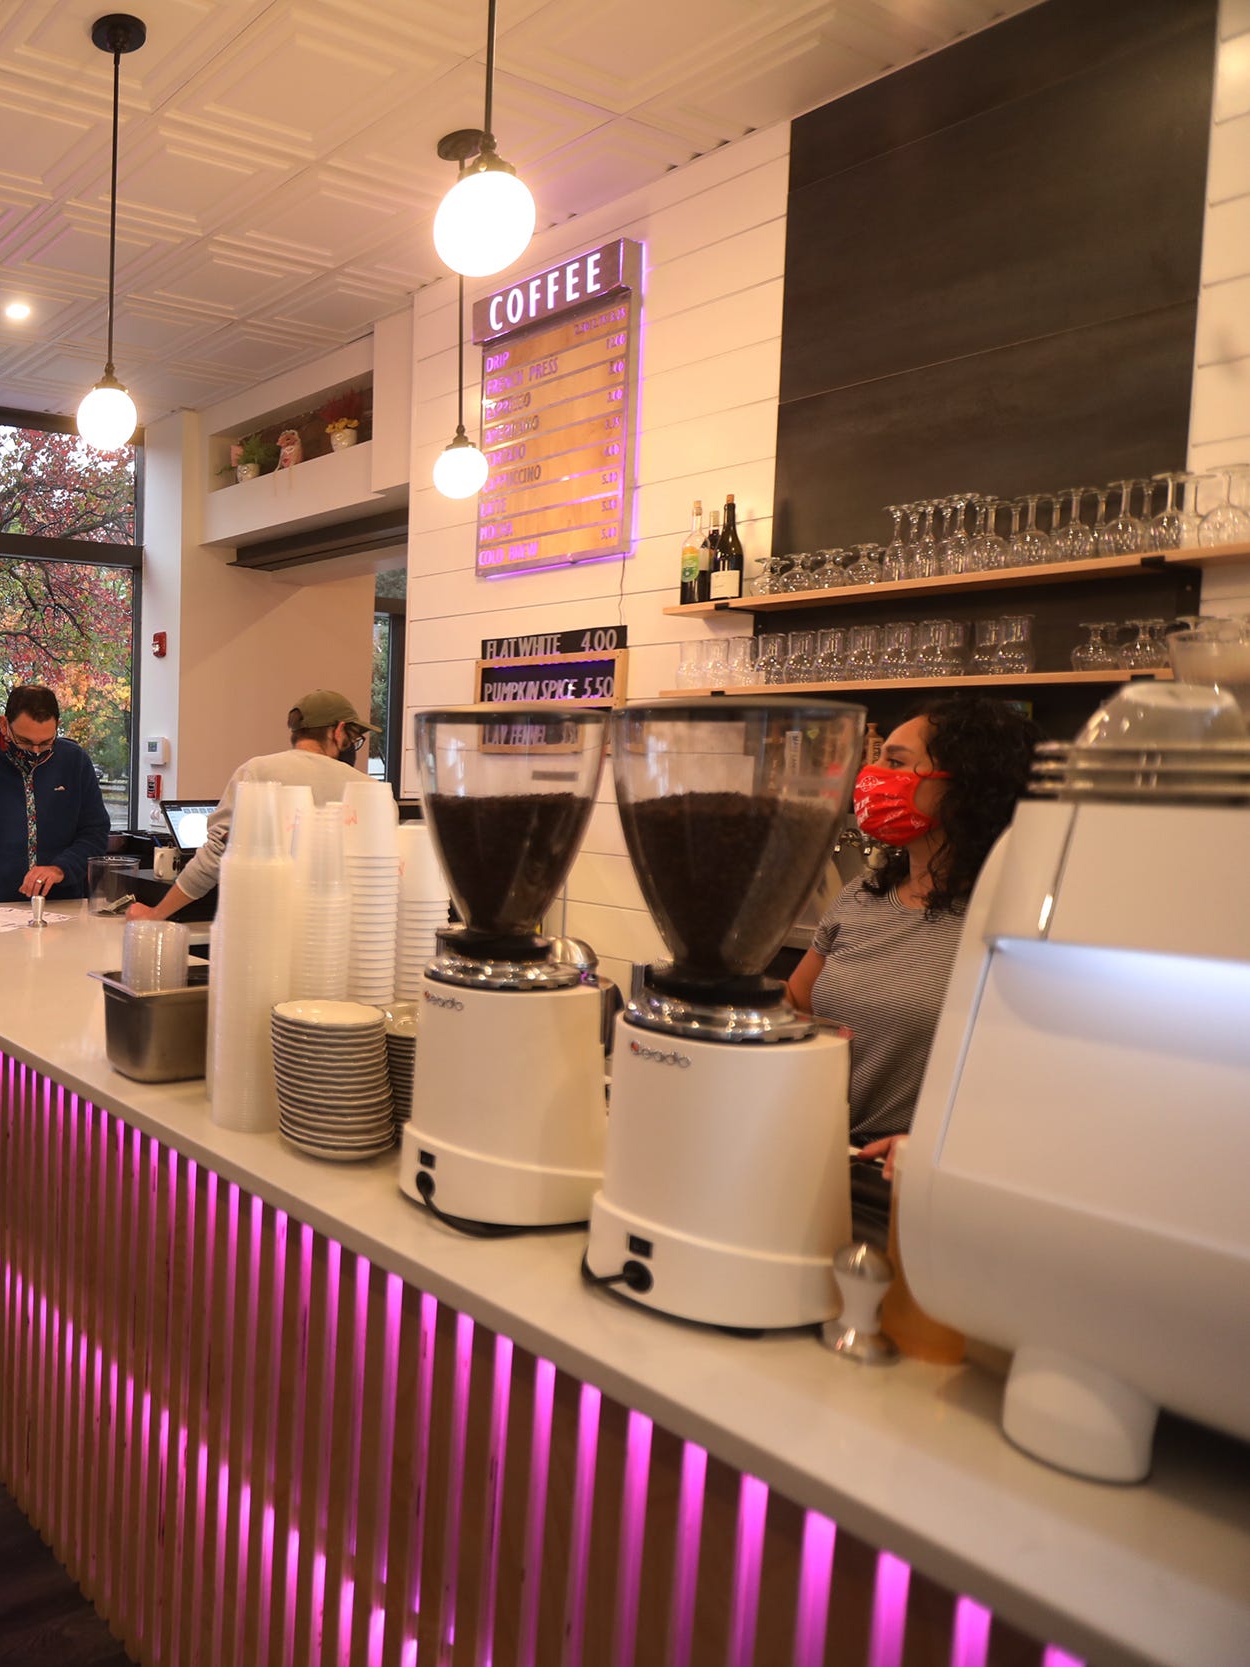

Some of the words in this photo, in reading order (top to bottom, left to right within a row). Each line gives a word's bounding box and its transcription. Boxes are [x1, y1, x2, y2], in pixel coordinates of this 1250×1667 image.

[489, 252, 601, 331] COFFEE
[486, 351, 510, 373] DRIP
[486, 370, 524, 396] FRENCH
[529, 357, 559, 382] PRESS
[480, 497, 507, 518] LATTE
[480, 521, 513, 541] MOCHA
[478, 547, 504, 567] COLD
[508, 541, 540, 561] BREW
[486, 639, 516, 659] FLAT
[518, 634, 562, 657] WHITE
[581, 629, 618, 651] 4.00
[484, 681, 540, 702] PUMPKIN
[541, 679, 578, 700] SPICE
[582, 677, 614, 699] 5.50
